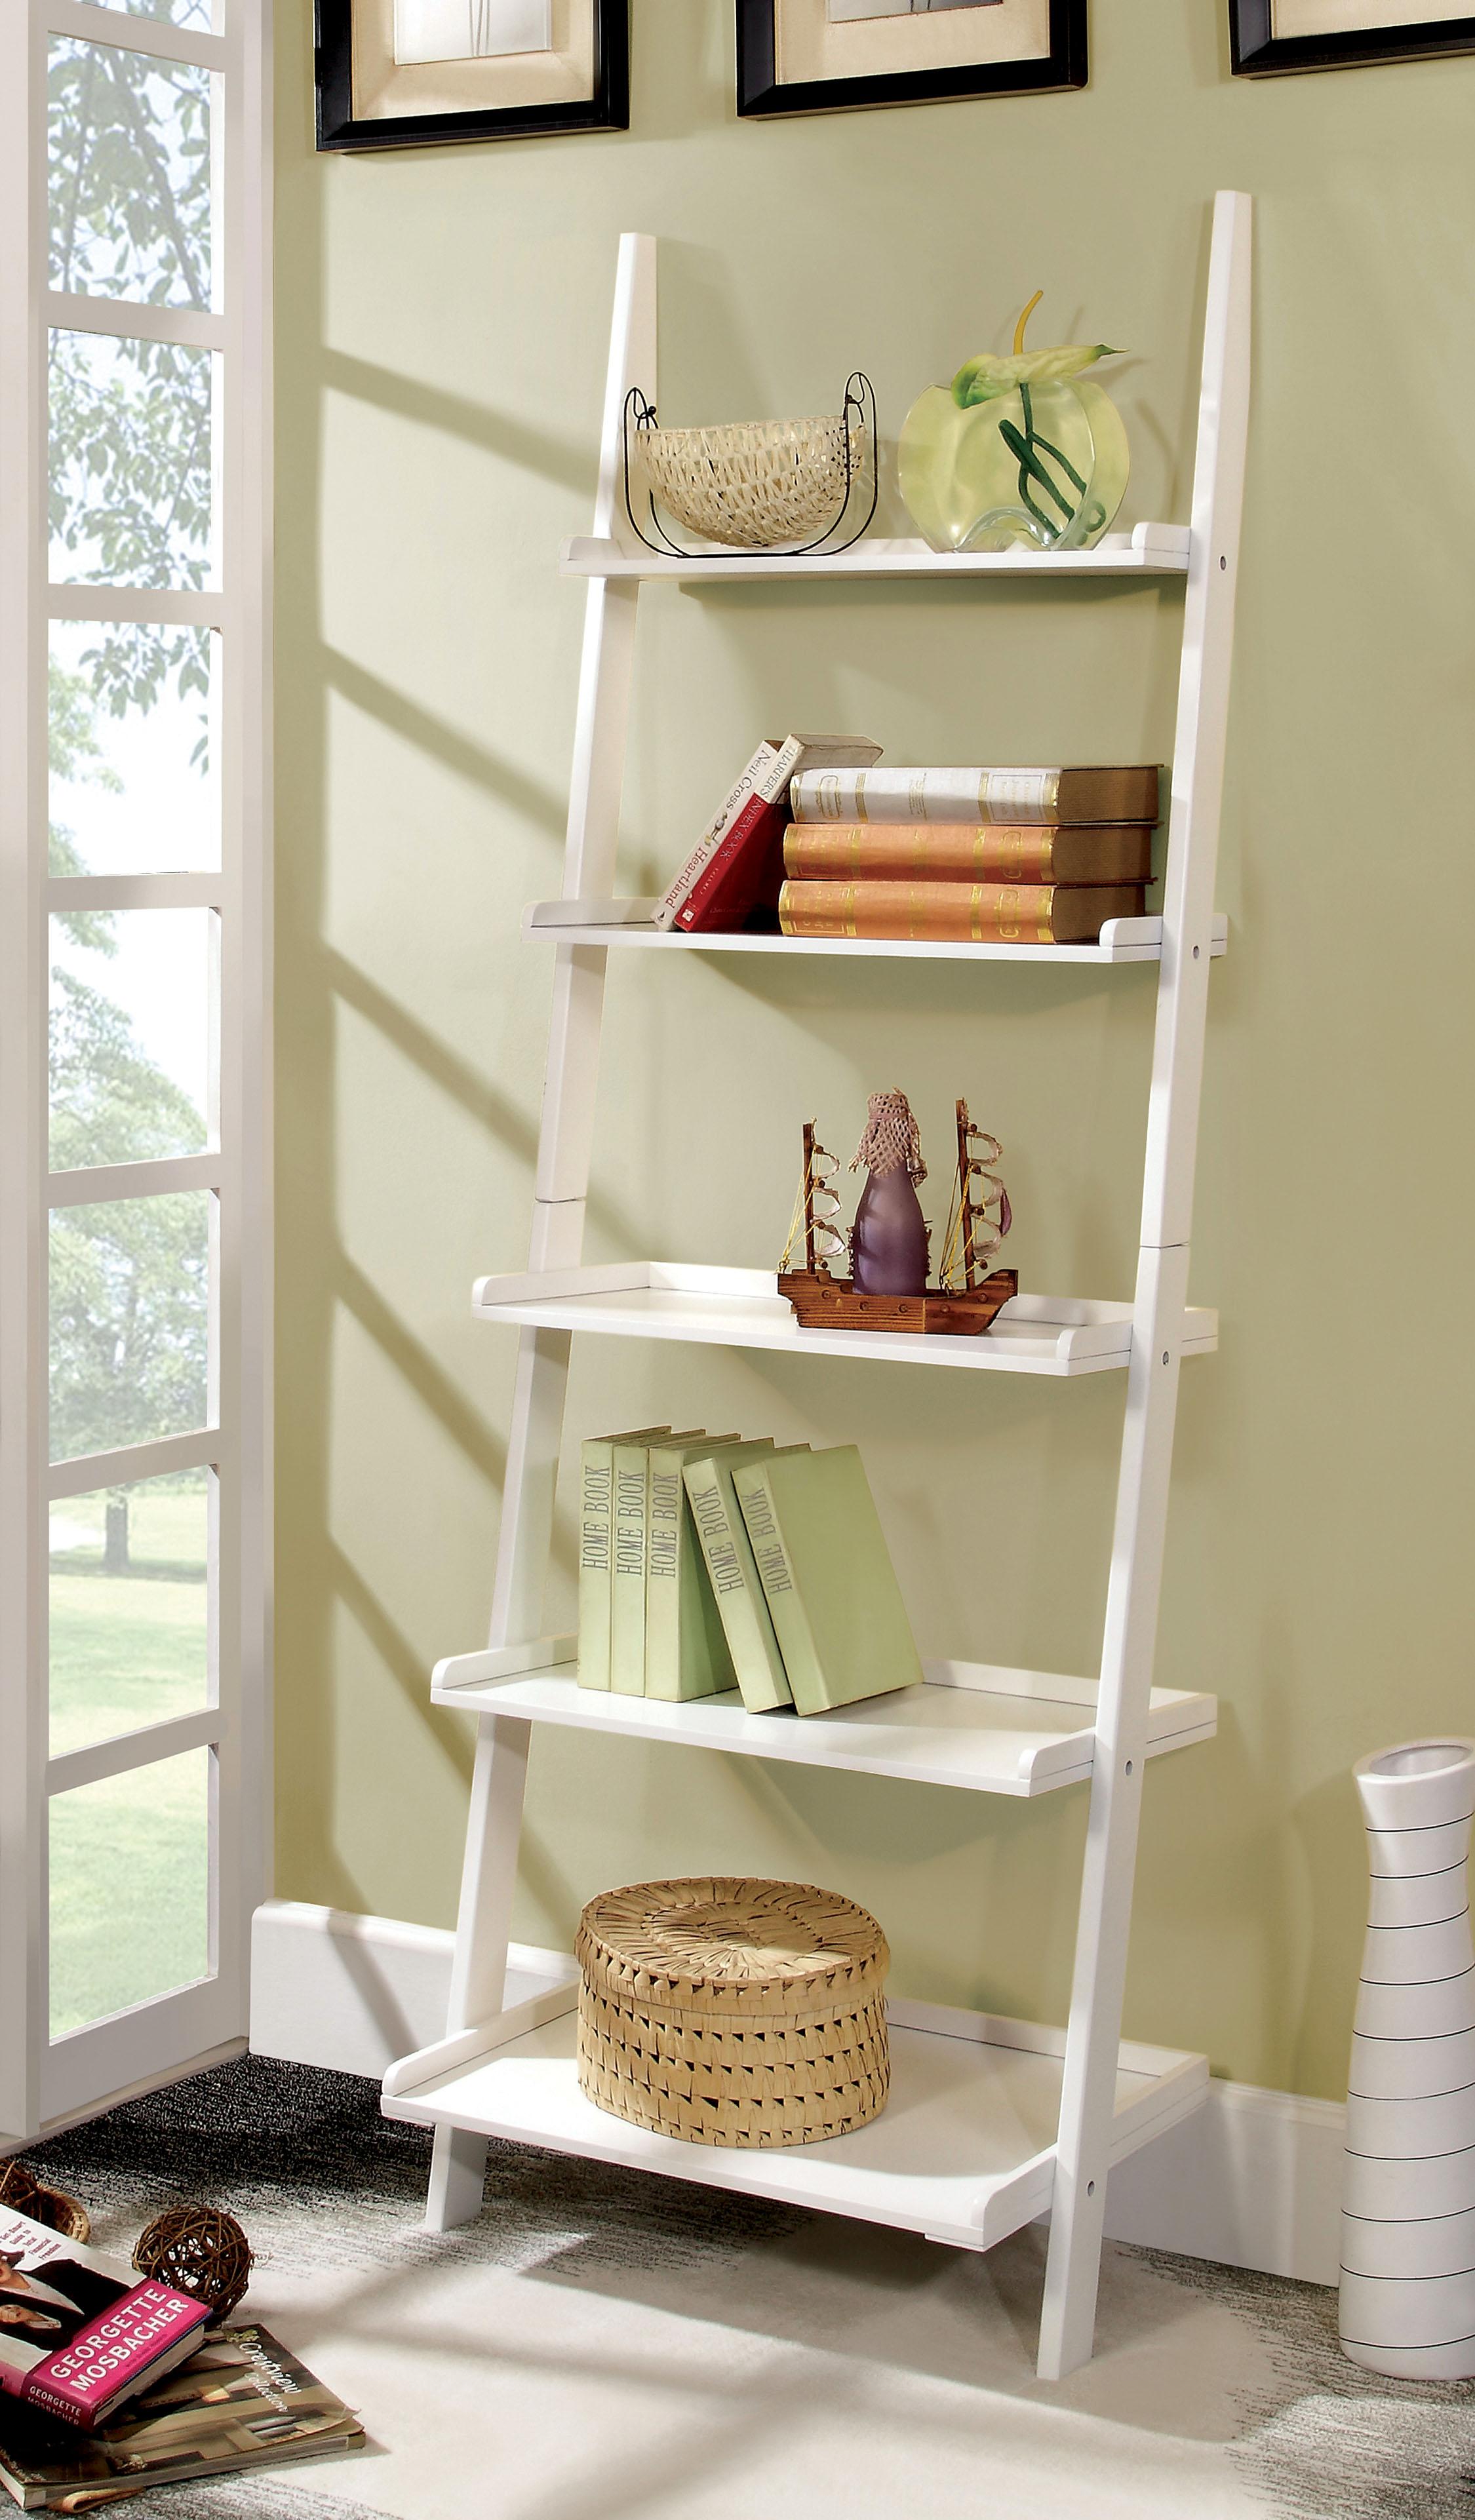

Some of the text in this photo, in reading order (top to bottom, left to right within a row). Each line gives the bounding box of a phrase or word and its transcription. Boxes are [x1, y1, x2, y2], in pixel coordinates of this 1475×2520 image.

[726, 749, 771, 810] Neil Cross
[760, 749, 793, 798] HARPER'S
[665, 846, 709, 909] Heartland
[582, 1465, 610, 1570] HOME BOOK
[616, 1470, 645, 1576] HOME BOOK
[650, 1473, 678, 1578] HOME BOOK
[692, 1484, 745, 1594] HOME BOOK
[740, 1485, 793, 1597] HOME BOOK
[50, 2287, 167, 2379] GEORGETTE
[69, 2297, 189, 2392] MOSBACHER
[239, 2342, 302, 2395] Crestview
[29, 2384, 83, 2417] GEORGETTE
